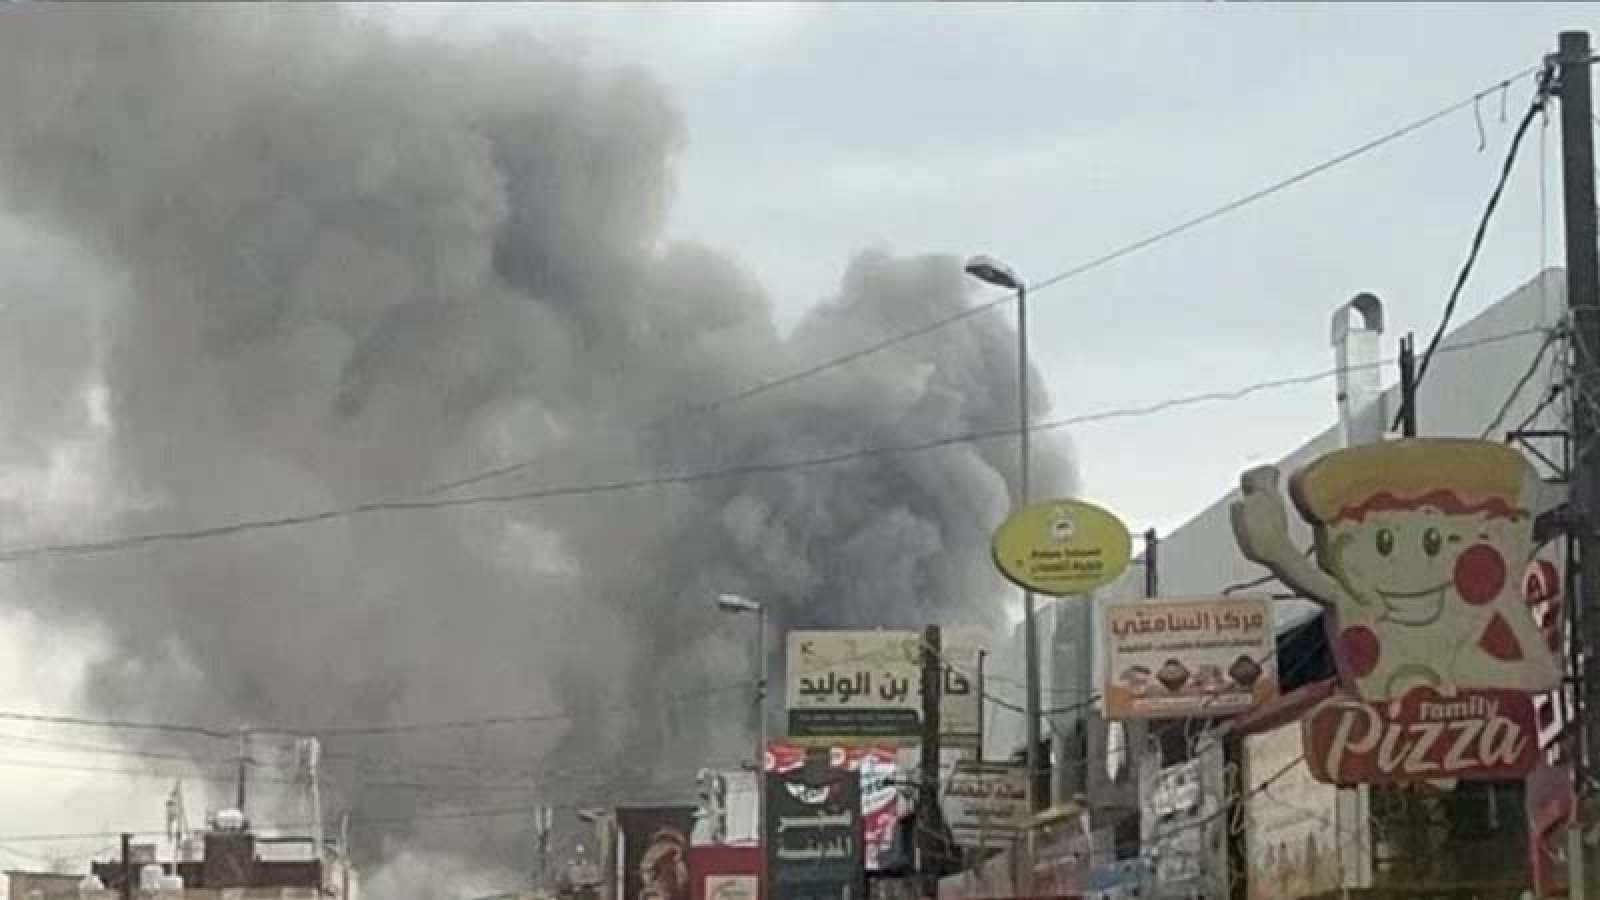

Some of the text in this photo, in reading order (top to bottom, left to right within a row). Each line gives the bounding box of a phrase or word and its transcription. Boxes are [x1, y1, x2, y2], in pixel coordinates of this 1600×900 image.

[799, 671, 871, 703] الوليد
[879, 671, 909, 702] بن
[1306, 699, 1528, 782] Pizza
